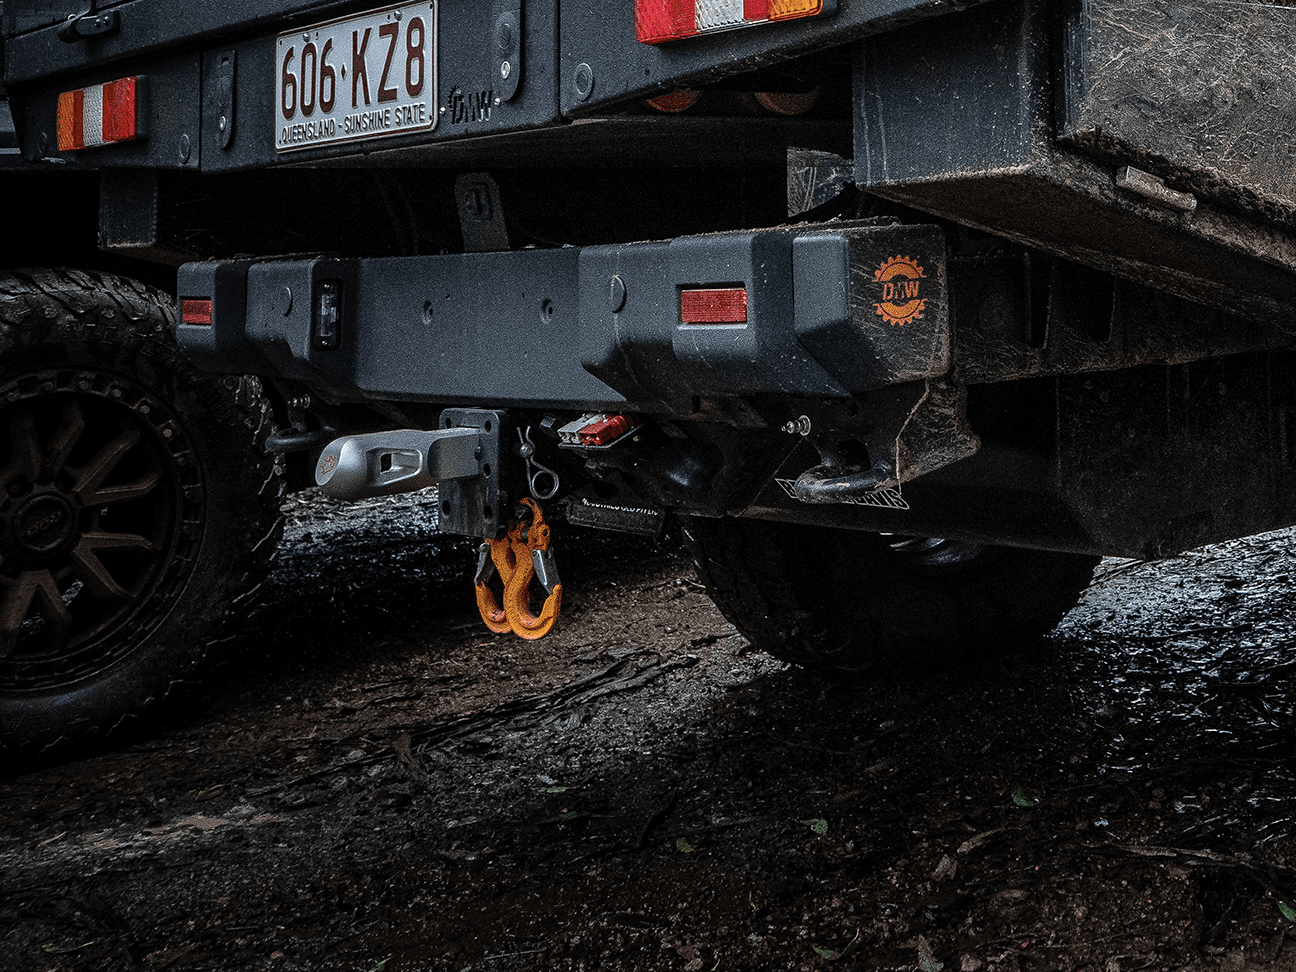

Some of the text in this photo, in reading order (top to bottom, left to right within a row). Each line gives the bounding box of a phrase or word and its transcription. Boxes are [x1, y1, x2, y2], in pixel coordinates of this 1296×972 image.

[281, 118, 336, 145] QUEENSLAND
[344, 108, 391, 134] SUNSHINE
[394, 102, 426, 126] STATE
[452, 90, 493, 125] DMW
[882, 281, 920, 301] DMW
